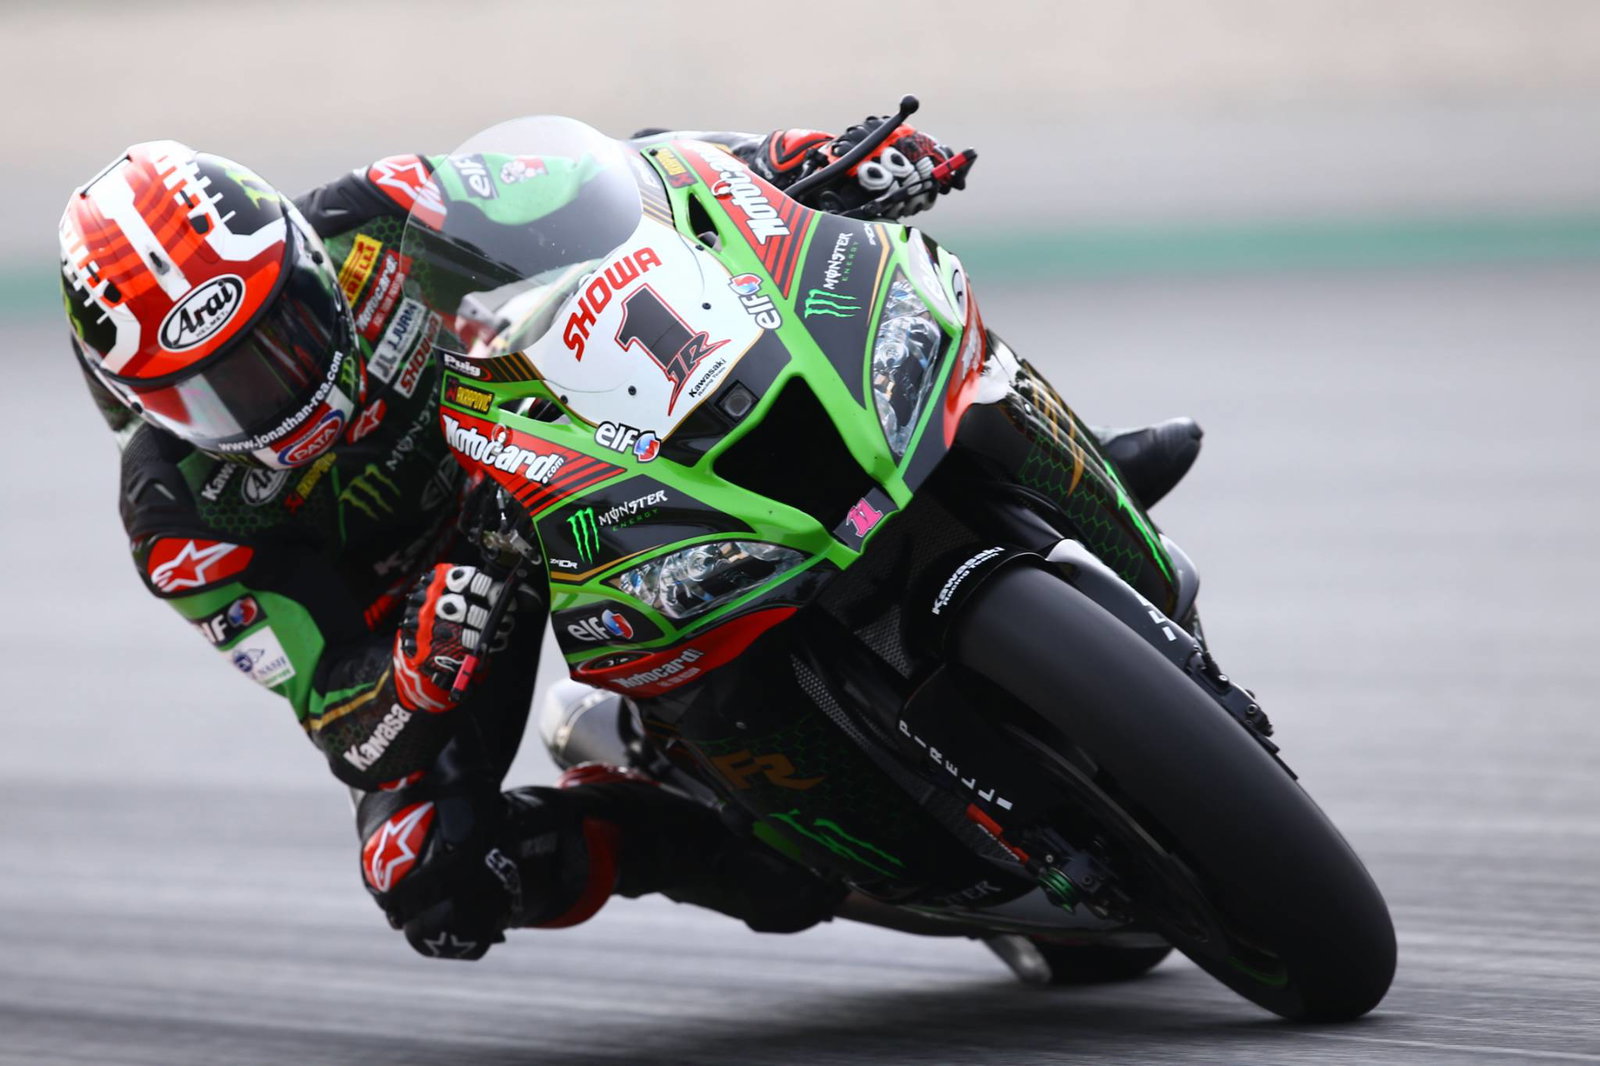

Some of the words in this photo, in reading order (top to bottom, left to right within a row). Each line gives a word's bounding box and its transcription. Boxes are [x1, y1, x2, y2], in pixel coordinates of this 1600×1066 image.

[346, 244, 376, 301] RELLI
[170, 281, 233, 346] Arai
[563, 247, 663, 362] SHOWA
[738, 293, 783, 330] elf
[444, 354, 481, 376] Puig
[688, 357, 727, 398] Kawasaki
[218, 351, 343, 452] www.jonathan-rea.com
[293, 426, 336, 462] PATA
[595, 421, 638, 452] elf
[599, 489, 668, 527] MONSTER
[611, 508, 660, 532] ENERGY
[932, 546, 1005, 615] Kawasaki
[200, 614, 229, 643] lf
[567, 616, 611, 641] elf
[343, 703, 413, 772] Kawasa
[899, 719, 1013, 810] PIRELLI
